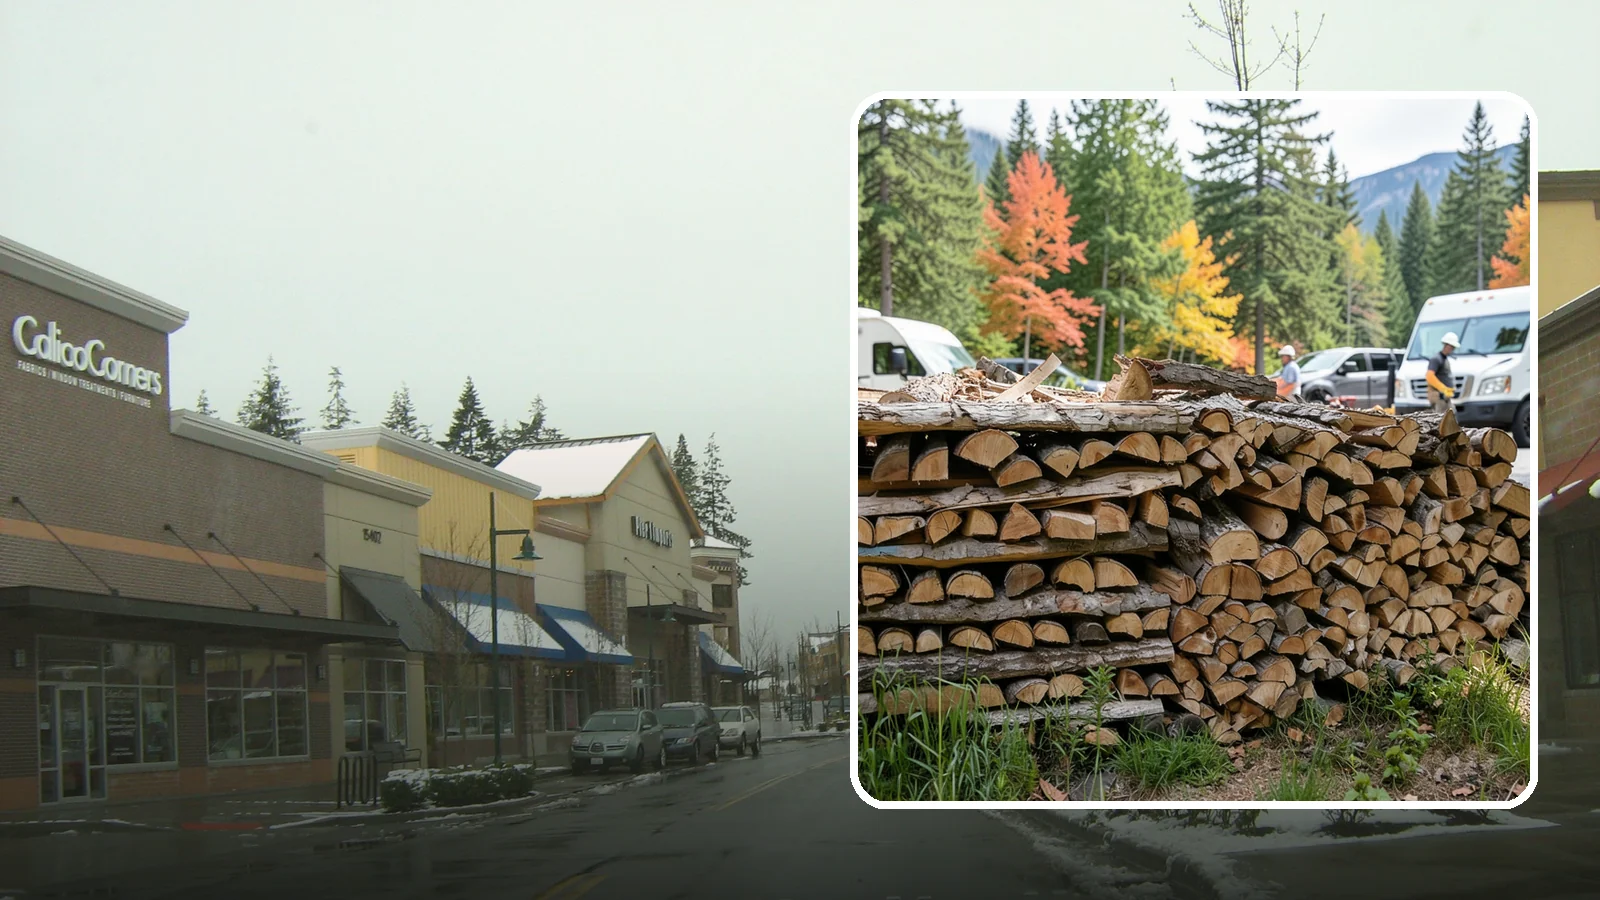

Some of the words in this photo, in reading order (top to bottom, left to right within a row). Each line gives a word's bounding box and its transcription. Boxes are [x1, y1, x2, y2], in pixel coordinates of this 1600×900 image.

[16, 360, 47, 377] FABRICS
[51, 370, 78, 387] WINDOW
[79, 379, 116, 398] TREATMENTS
